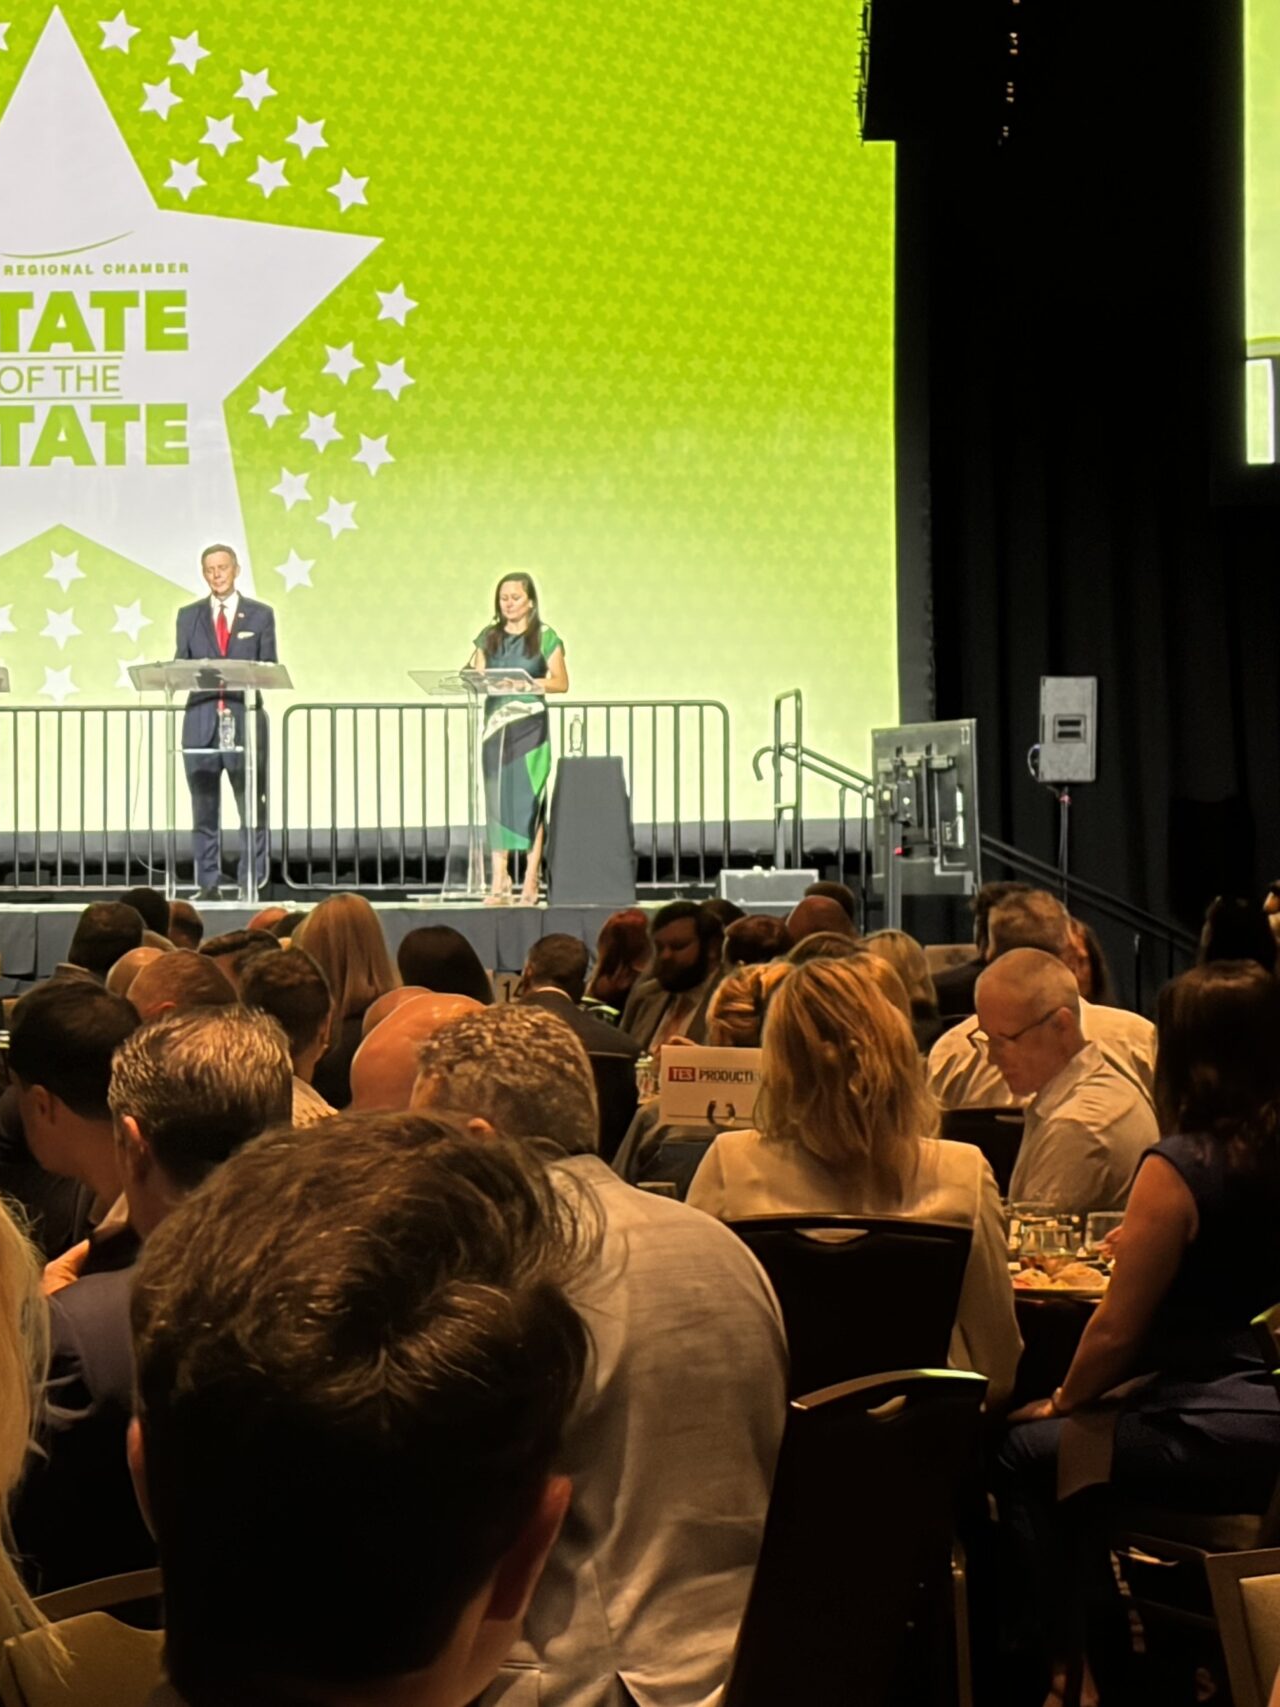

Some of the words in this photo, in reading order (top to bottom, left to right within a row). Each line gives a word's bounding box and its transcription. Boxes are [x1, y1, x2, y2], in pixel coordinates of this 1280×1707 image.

[3, 263, 95, 276] REGIONAL
[102, 262, 190, 275] CHAMBER
[52, 364, 120, 393] THE
[700, 1070, 758, 1082] PRODUCTI
